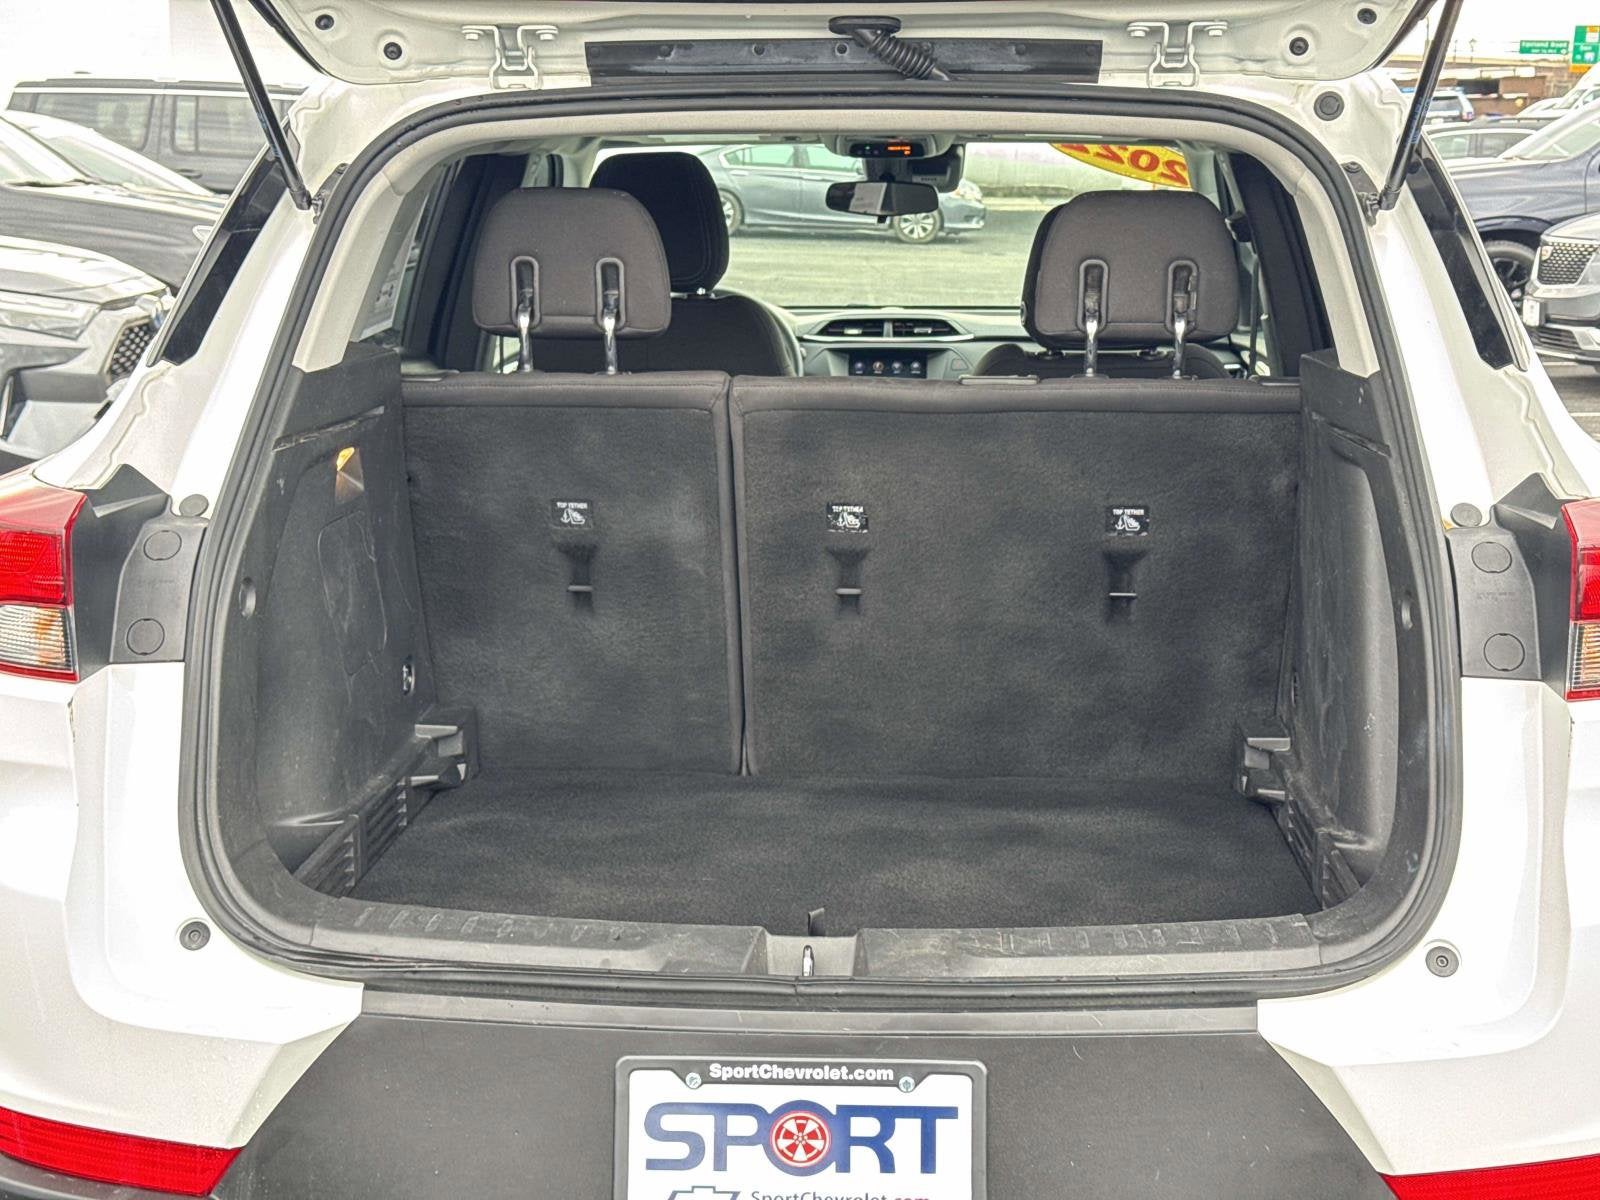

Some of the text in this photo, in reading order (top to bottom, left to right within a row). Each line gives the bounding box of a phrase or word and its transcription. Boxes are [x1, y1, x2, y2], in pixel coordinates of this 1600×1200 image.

[556, 501, 568, 509] TOP
[1112, 508, 1145, 516] TOP TETHER
[708, 1063, 895, 1081] SportChevrolet.com
[643, 1099, 959, 1177] SPORT
[750, 1190, 930, 1200] SportChevrolet
